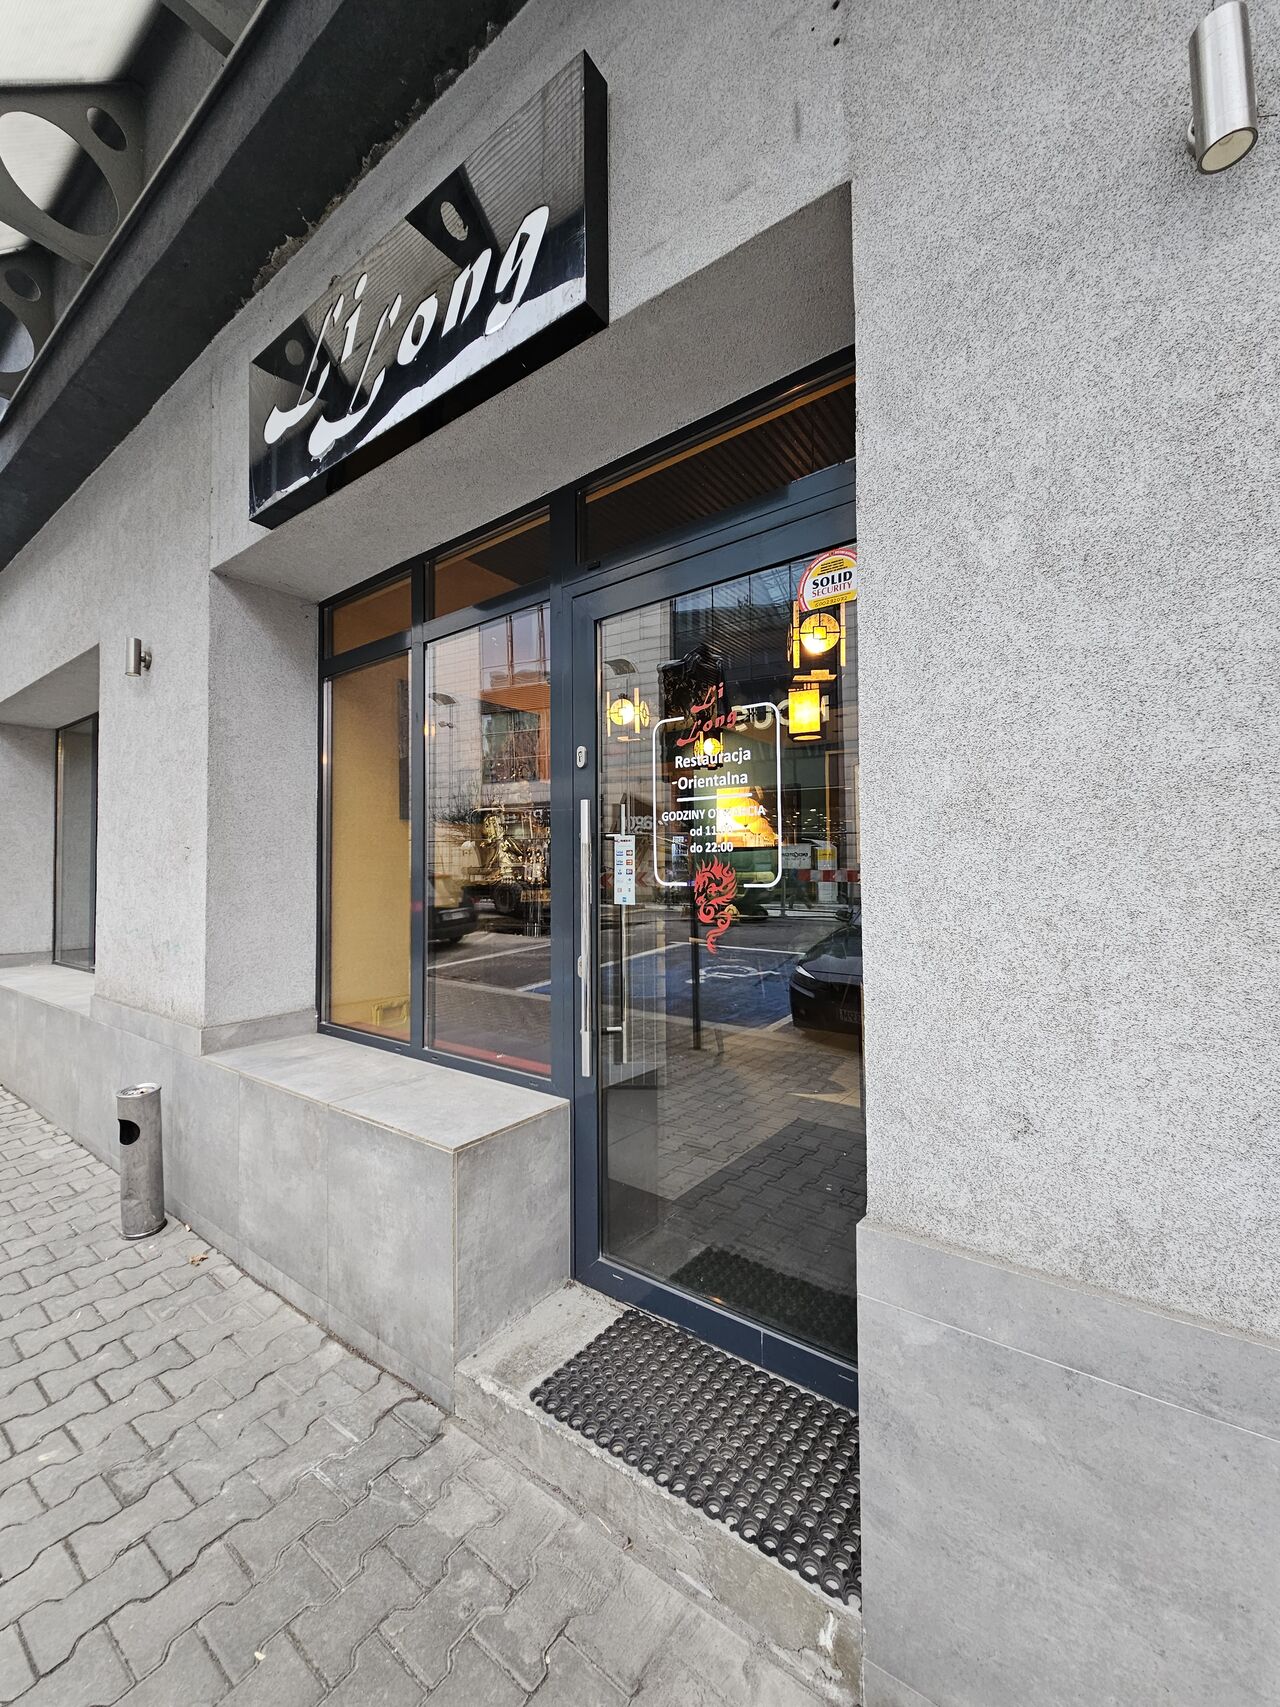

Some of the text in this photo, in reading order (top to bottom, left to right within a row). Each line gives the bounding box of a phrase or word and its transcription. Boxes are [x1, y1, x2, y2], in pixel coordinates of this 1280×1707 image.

[812, 571, 852, 589] SOLID
[812, 581, 852, 597] SECURITY
[675, 747, 751, 768] Restauracja
[661, 804, 767, 822] GODZINY OARCIA
[689, 825, 703, 837] od
[689, 841, 734, 853] do 22:00
